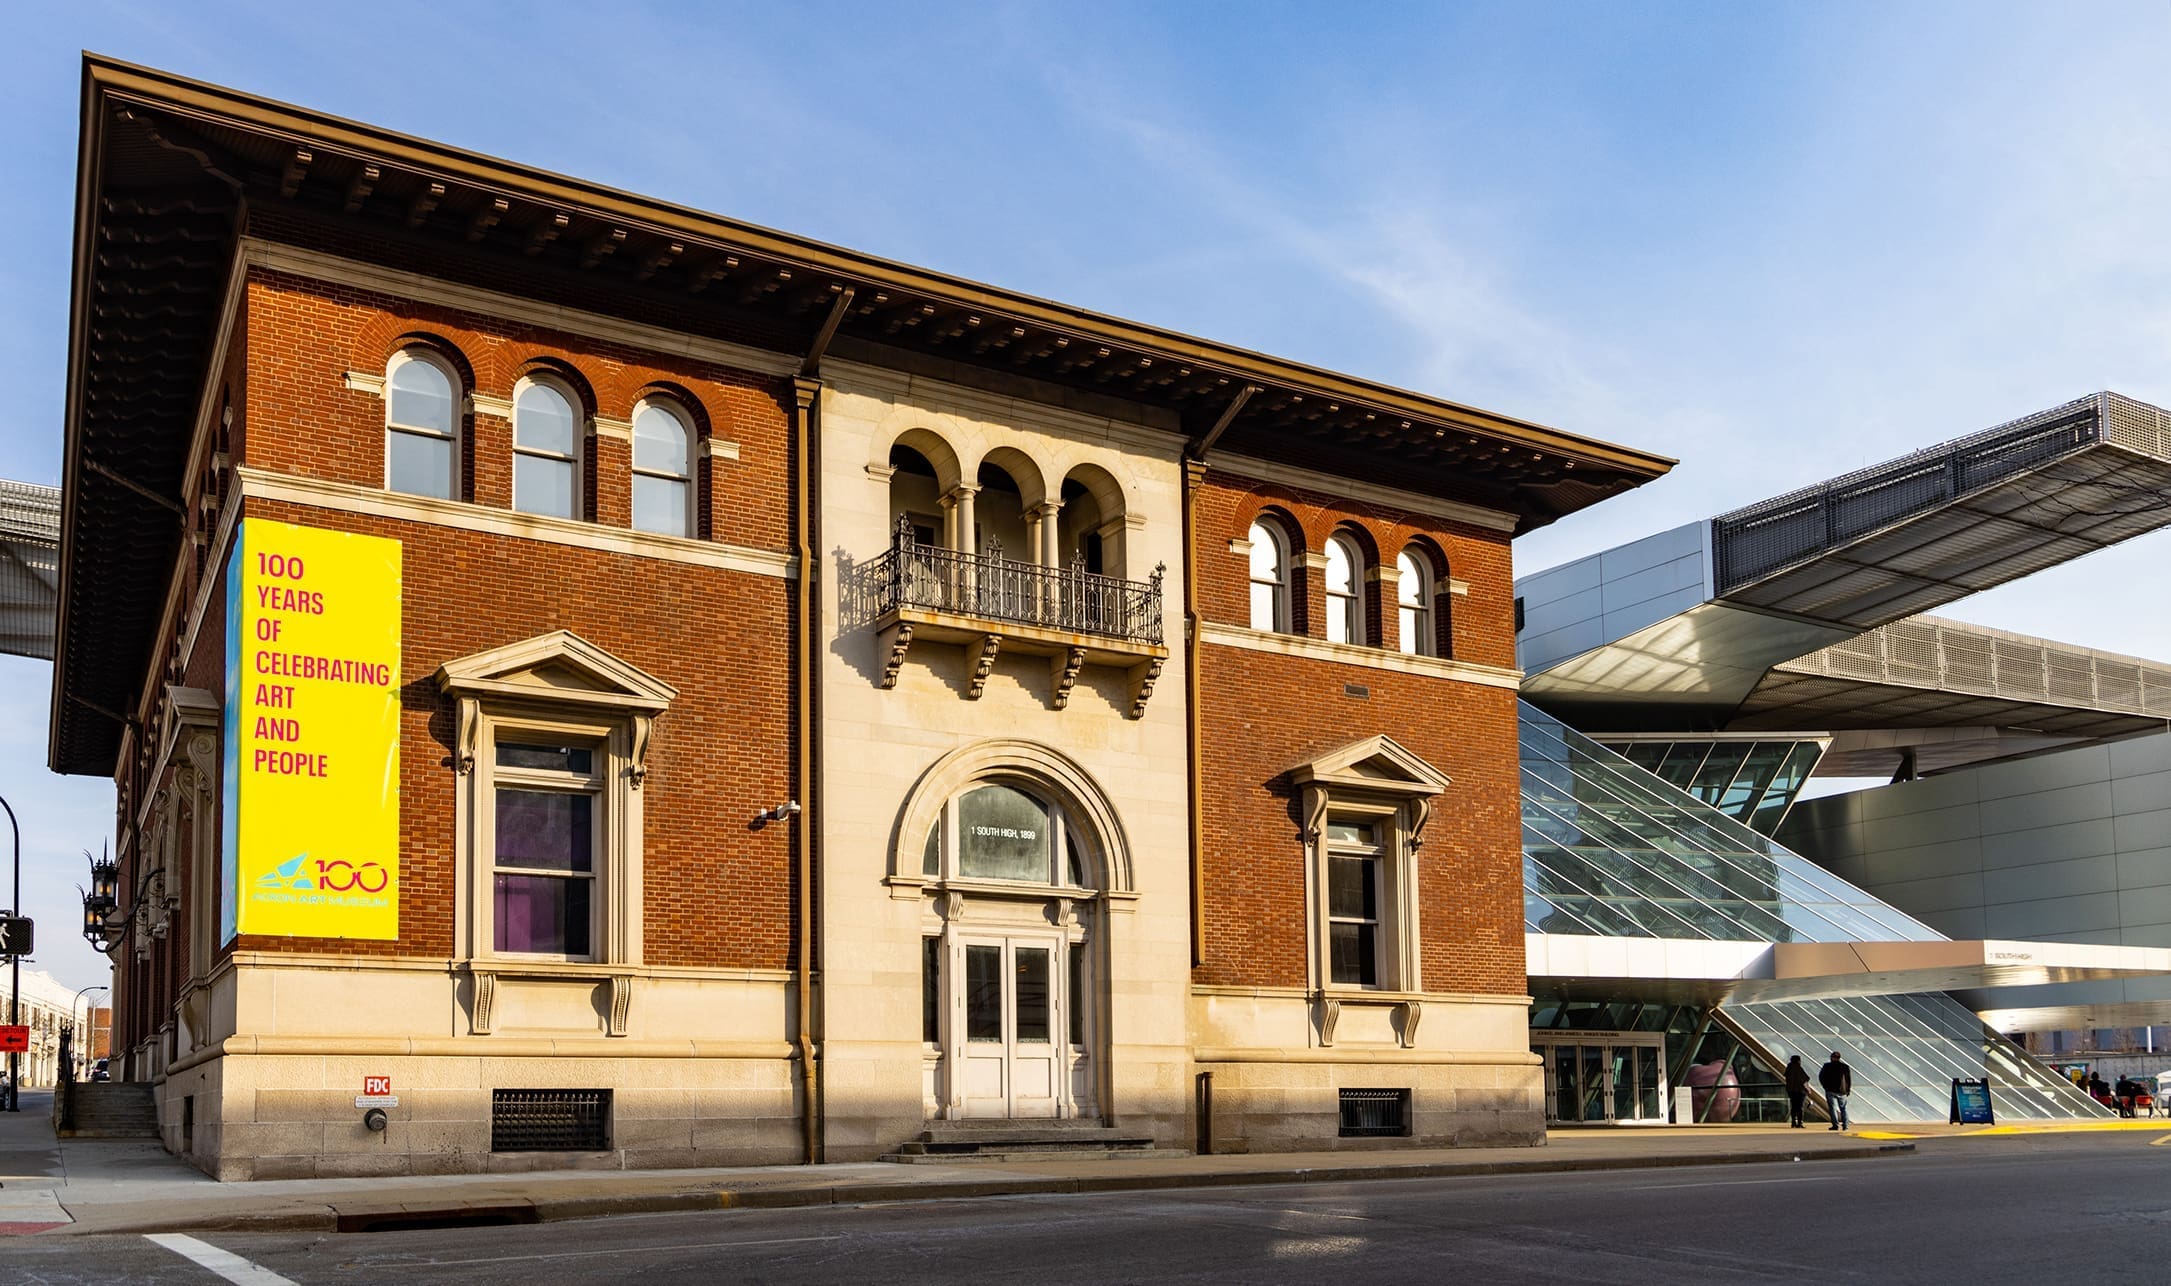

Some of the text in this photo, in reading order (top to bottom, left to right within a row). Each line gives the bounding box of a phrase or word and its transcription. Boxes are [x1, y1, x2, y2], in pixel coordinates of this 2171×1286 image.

[258, 552, 304, 580] 100
[257, 585, 324, 615] YEARS
[256, 618, 282, 642] OF
[256, 650, 390, 687] CELEBRATING
[255, 683, 295, 709] ART
[254, 716, 299, 742] AND
[254, 749, 328, 777] PEOPLE
[971, 826, 1036, 840] 1 SOUTH HIGH, 1899
[315, 859, 388, 893] 100
[299, 894, 326, 906] ART
[366, 1078, 389, 1093] FDC
